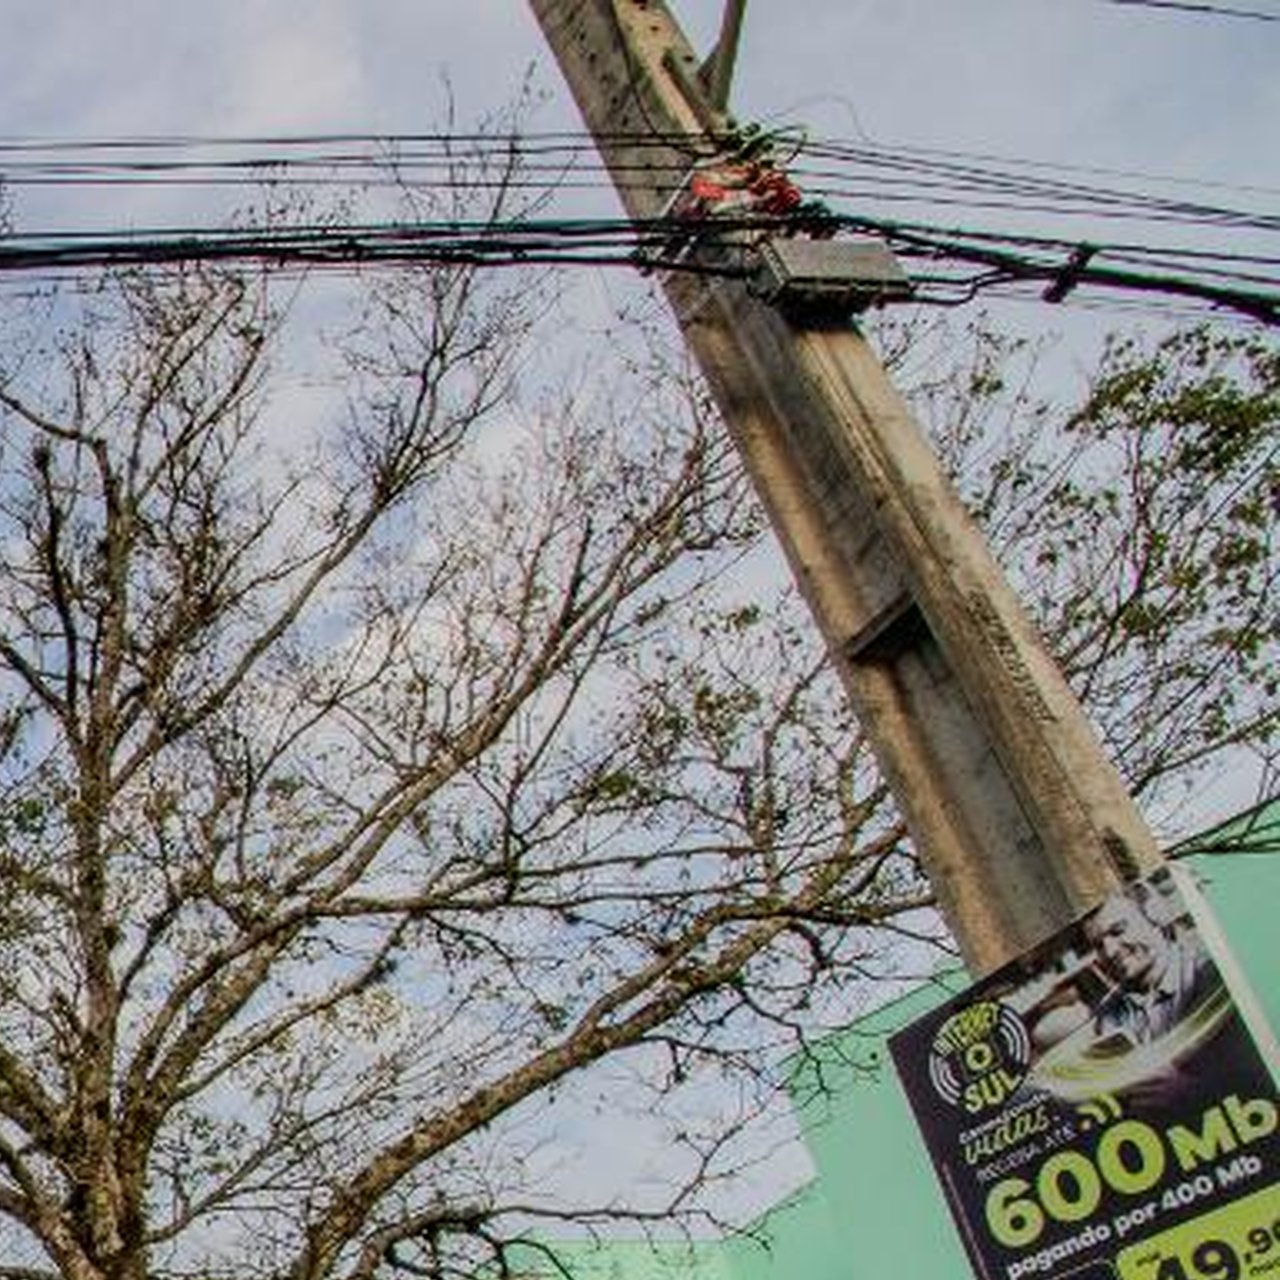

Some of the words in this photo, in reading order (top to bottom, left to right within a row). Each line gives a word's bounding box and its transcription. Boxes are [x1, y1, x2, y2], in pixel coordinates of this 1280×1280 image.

[965, 1069, 1023, 1114] SUL
[1113, 1202, 1158, 1238] por
[1161, 1174, 1214, 1210] 400
[1215, 1155, 1262, 1187] Mb
